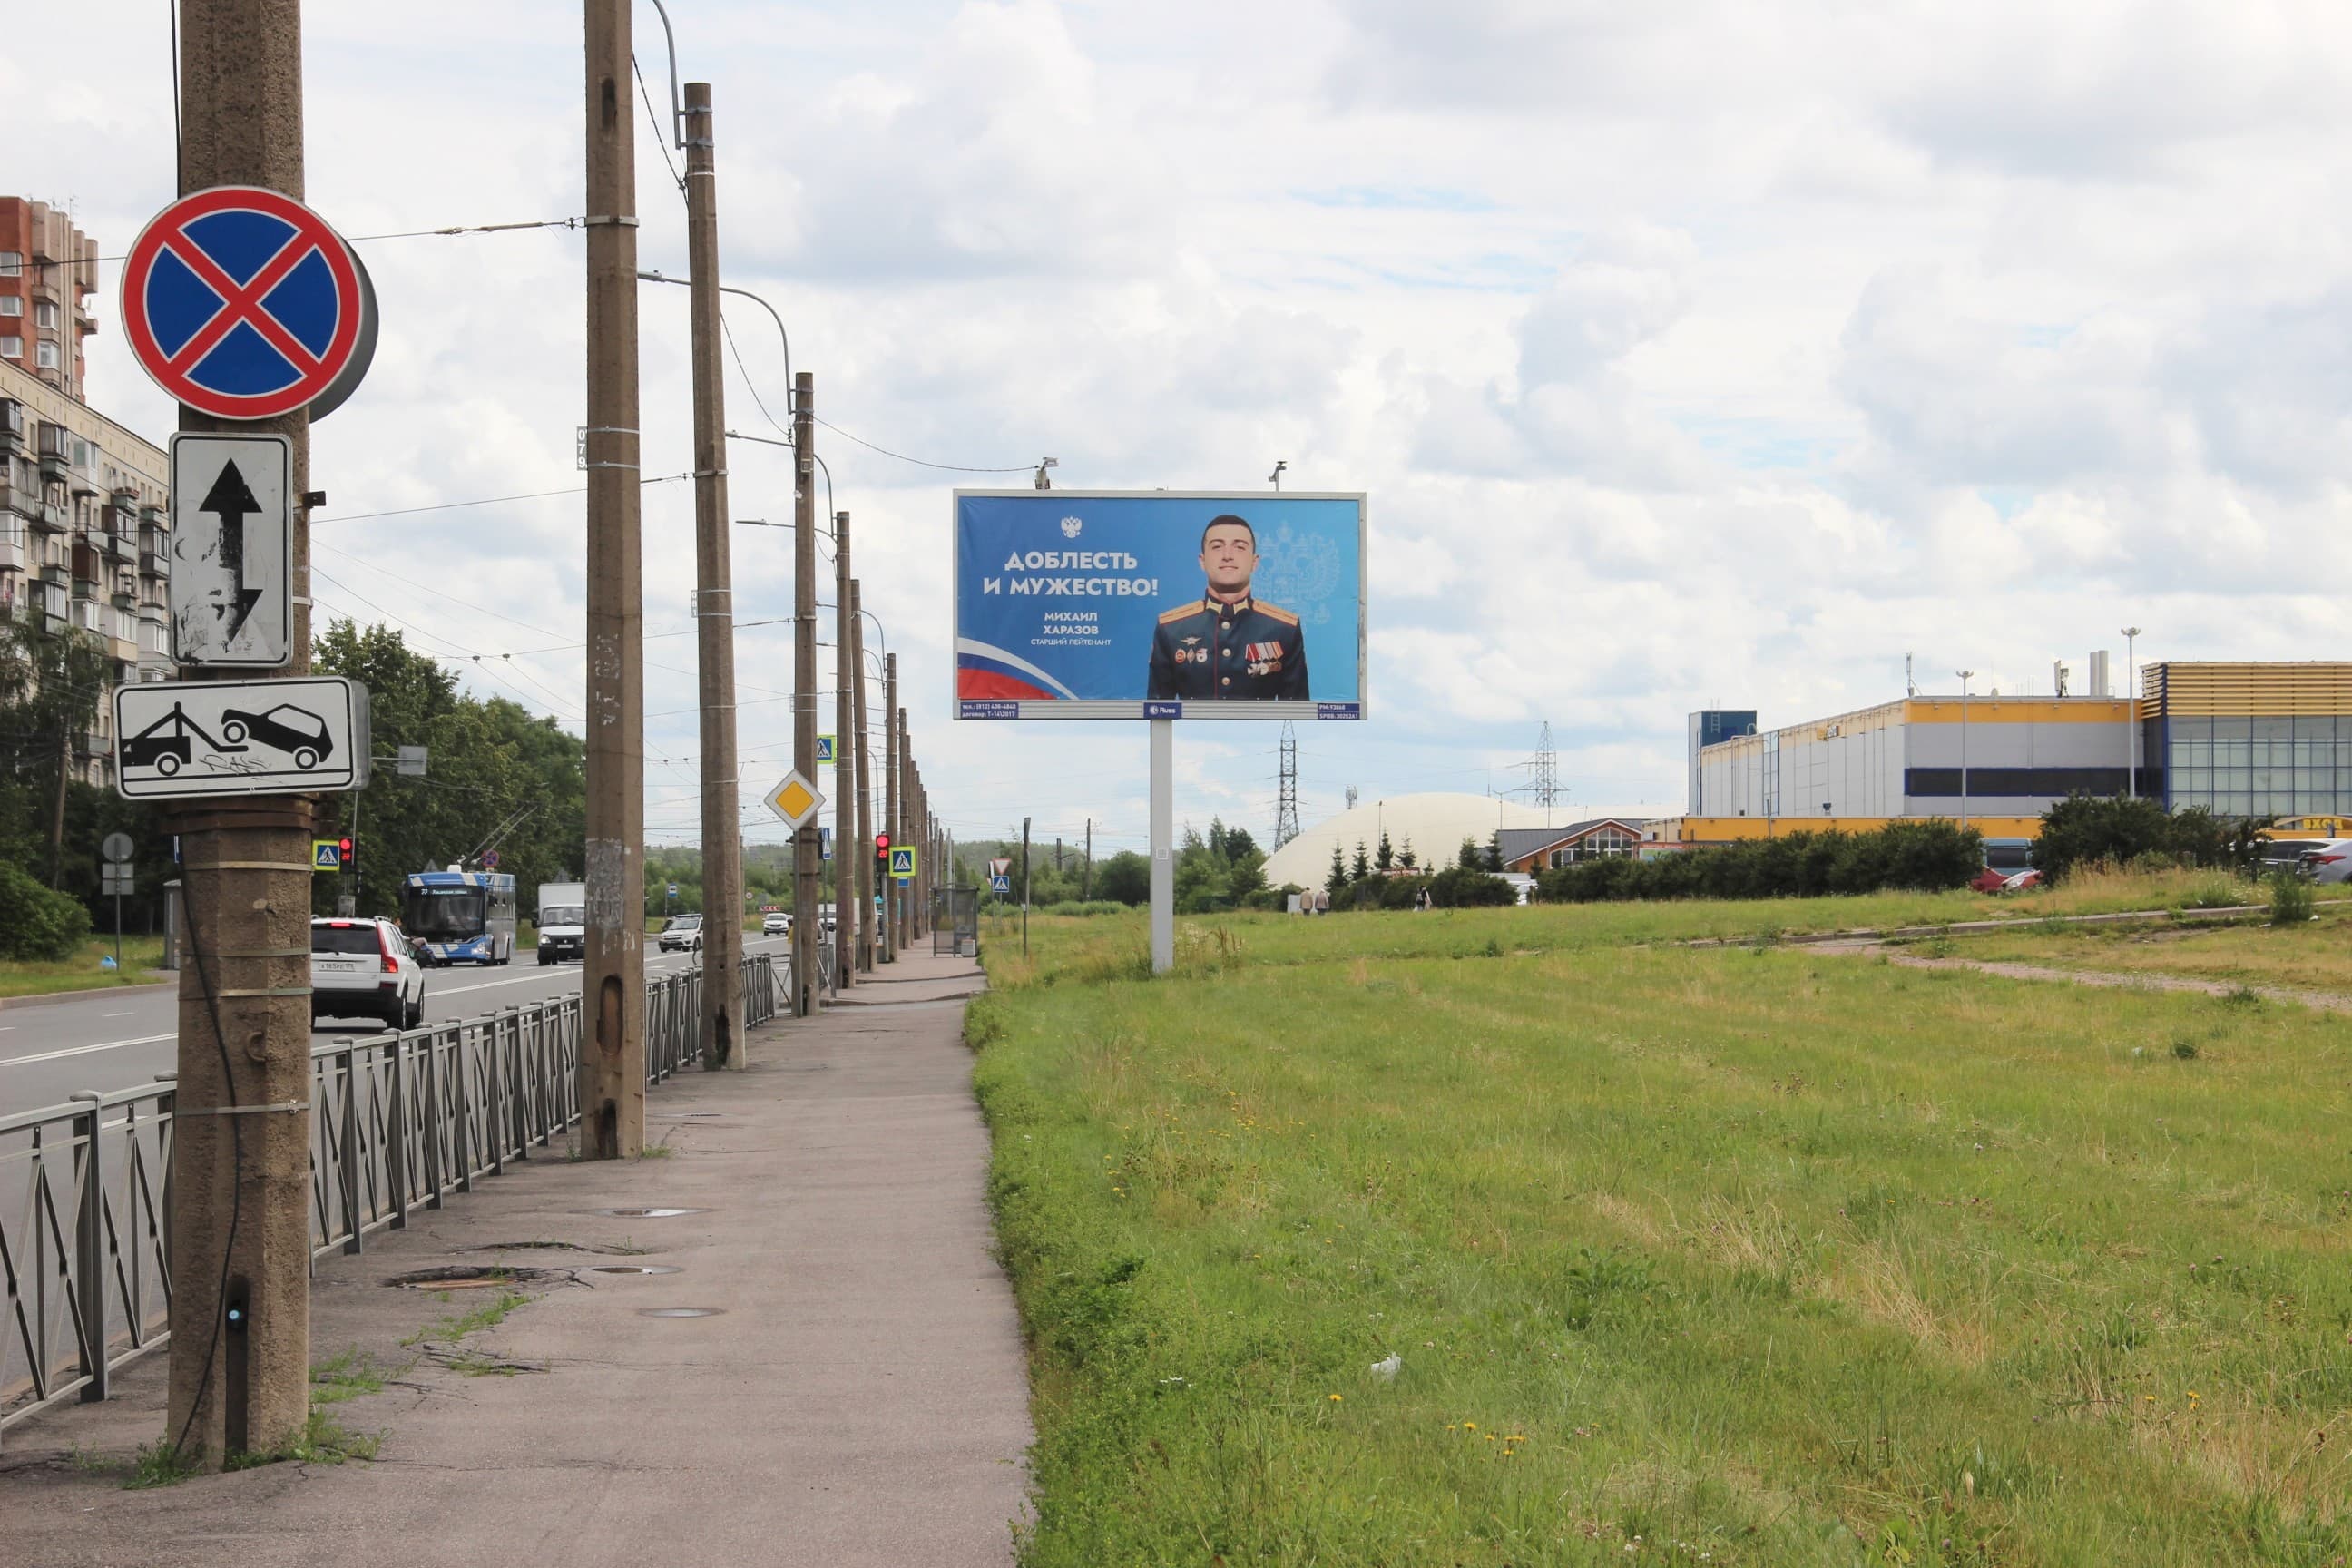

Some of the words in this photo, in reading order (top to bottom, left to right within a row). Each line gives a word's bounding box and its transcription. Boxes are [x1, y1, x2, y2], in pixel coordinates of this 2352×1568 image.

[1004, 551, 1138, 572] ДОБЛЕСТЬ
[983, 577, 1001, 595] И
[1009, 577, 1159, 597] МУЖЕСТВО!
[1044, 612, 1098, 622] МИХАИЛ
[1043, 624, 1100, 635] ХАРАЗОВ
[1030, 637, 1067, 646] СТАРШИЙ
[1068, 637, 1112, 646] ЛЕЙТЕНАНТ
[2303, 818, 2344, 829] ВХОД
